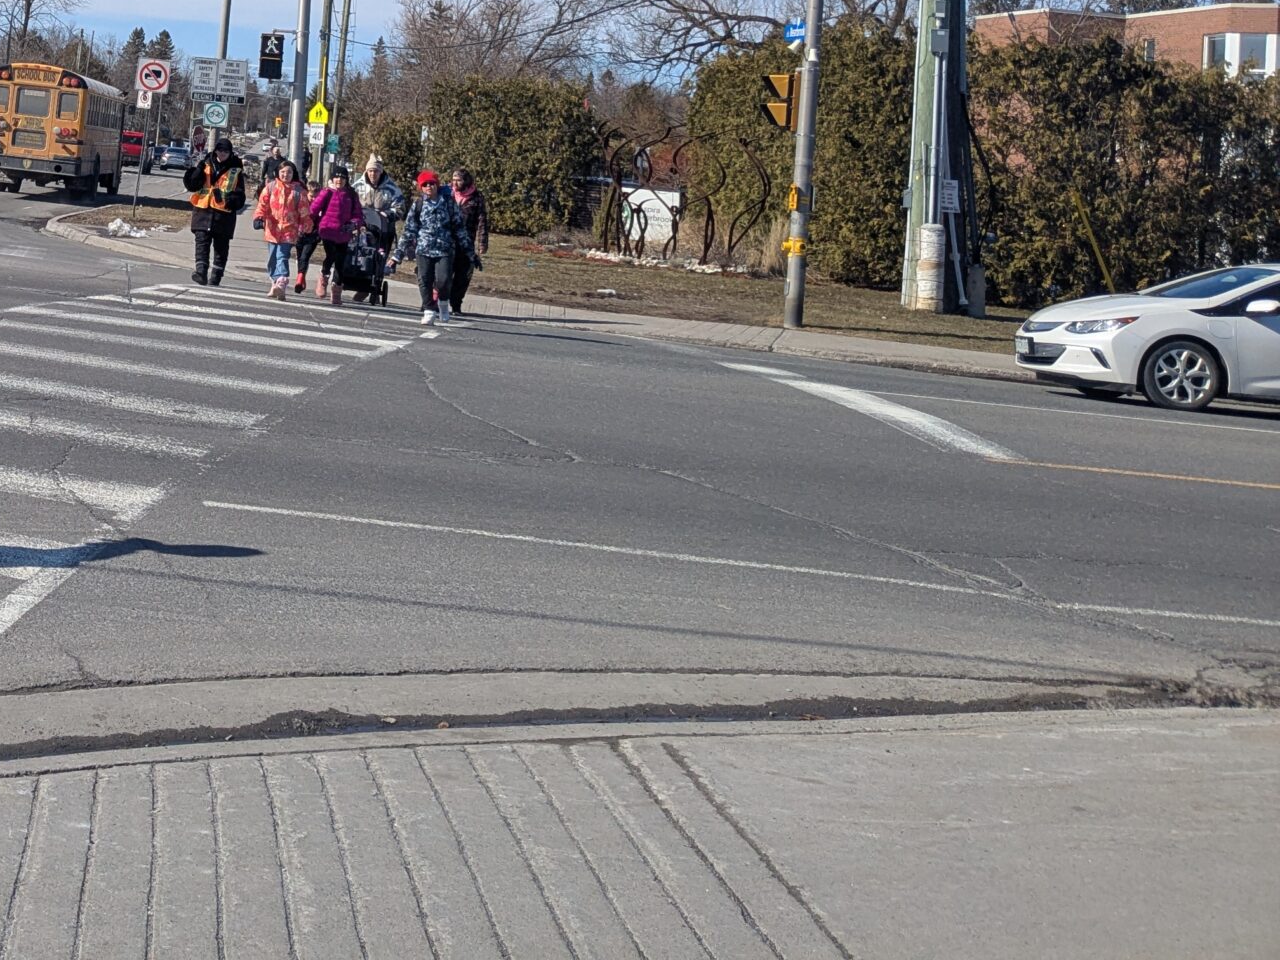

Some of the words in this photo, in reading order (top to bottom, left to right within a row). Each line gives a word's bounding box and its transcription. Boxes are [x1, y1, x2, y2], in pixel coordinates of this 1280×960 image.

[16, 69, 41, 81] SCHOOL
[43, 72, 56, 82] BUS
[312, 132, 322, 141] 40
